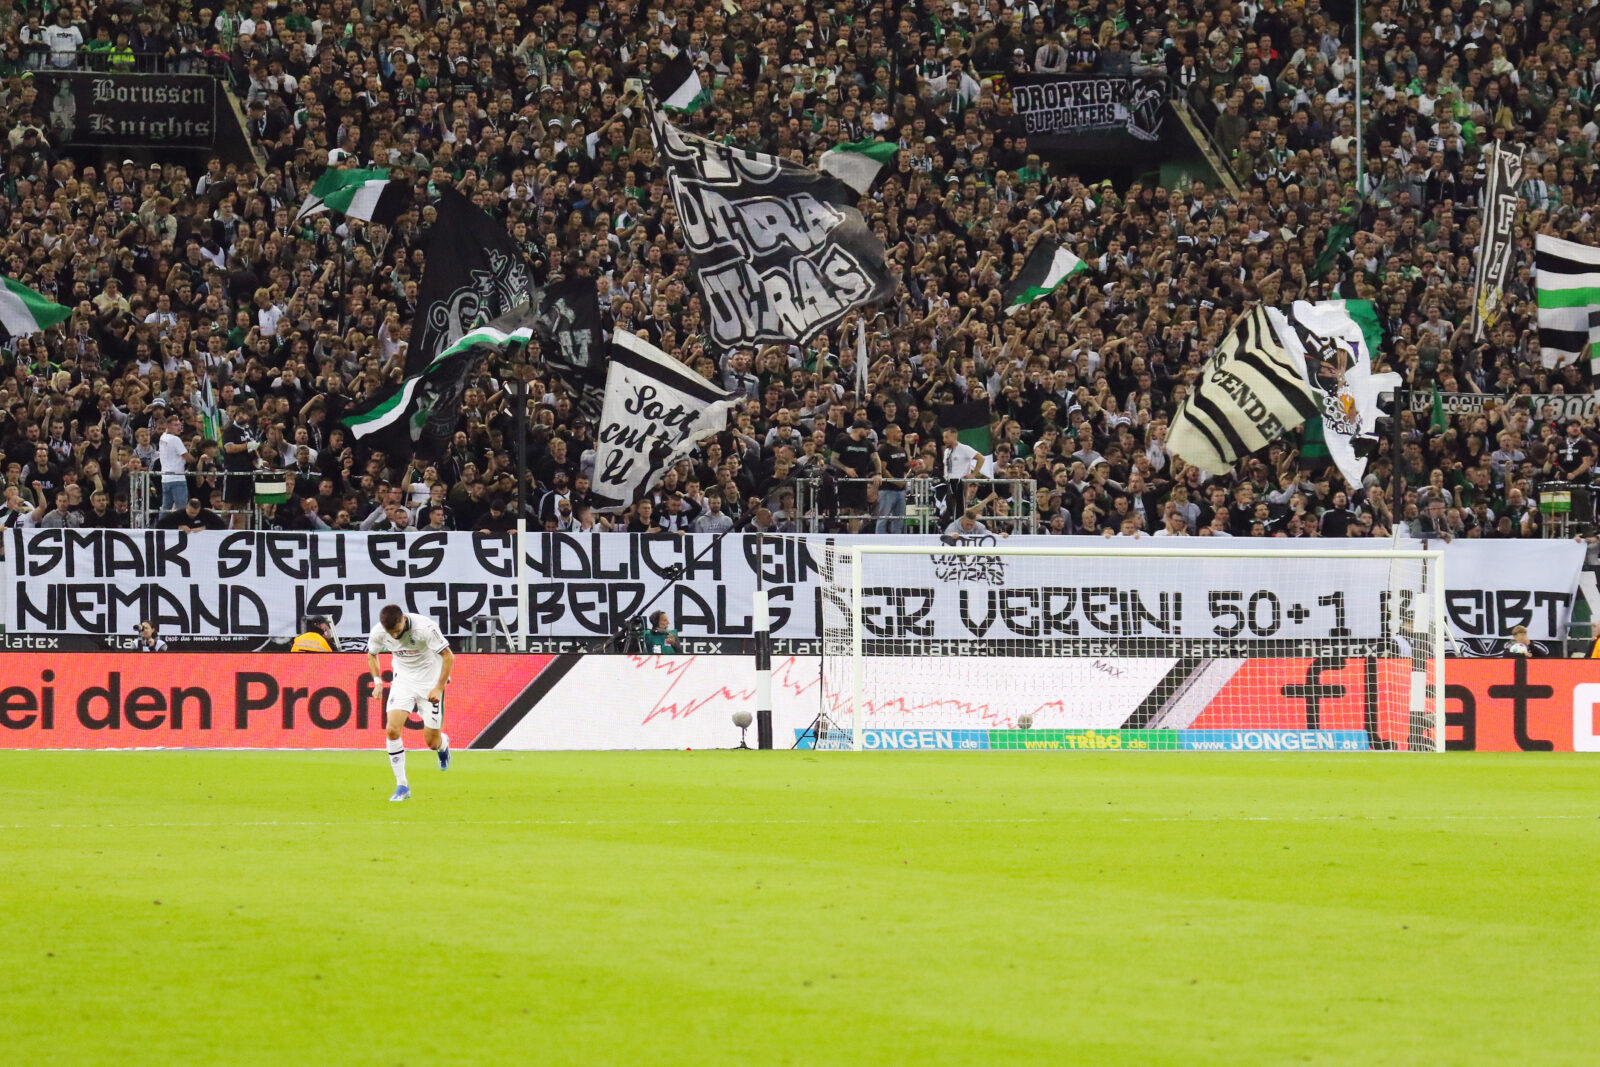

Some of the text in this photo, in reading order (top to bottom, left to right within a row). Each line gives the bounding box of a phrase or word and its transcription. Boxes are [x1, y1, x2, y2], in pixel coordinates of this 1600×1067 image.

[92, 78, 205, 104] Borussen
[1014, 80, 1128, 113] DROPKICK
[89, 113, 210, 139] Knights
[1026, 103, 1115, 133] SUPPORTERS
[13, 529, 191, 578] ISMAIK
[218, 530, 347, 578] SIEH
[368, 532, 447, 578] ES
[472, 532, 722, 581] ENDLICH
[743, 534, 834, 583] EIN
[17, 581, 269, 634] NIEMAND
[296, 583, 386, 633] IST
[674, 585, 793, 635] ALS
[815, 585, 934, 638] DER
[959, 587, 1182, 637] VEREIN!
[1208, 590, 1351, 638] 50+1
[1380, 589, 1574, 638] BEIBT
[104, 635, 139, 649] fla
[506, 637, 588, 653] fatex
[908, 640, 987, 656] flatex
[1040, 640, 1118, 656] flatex
[76, 671, 212, 730] den
[862, 731, 954, 749] ONGEN
[1191, 731, 1358, 750] www. JONGEN .de
